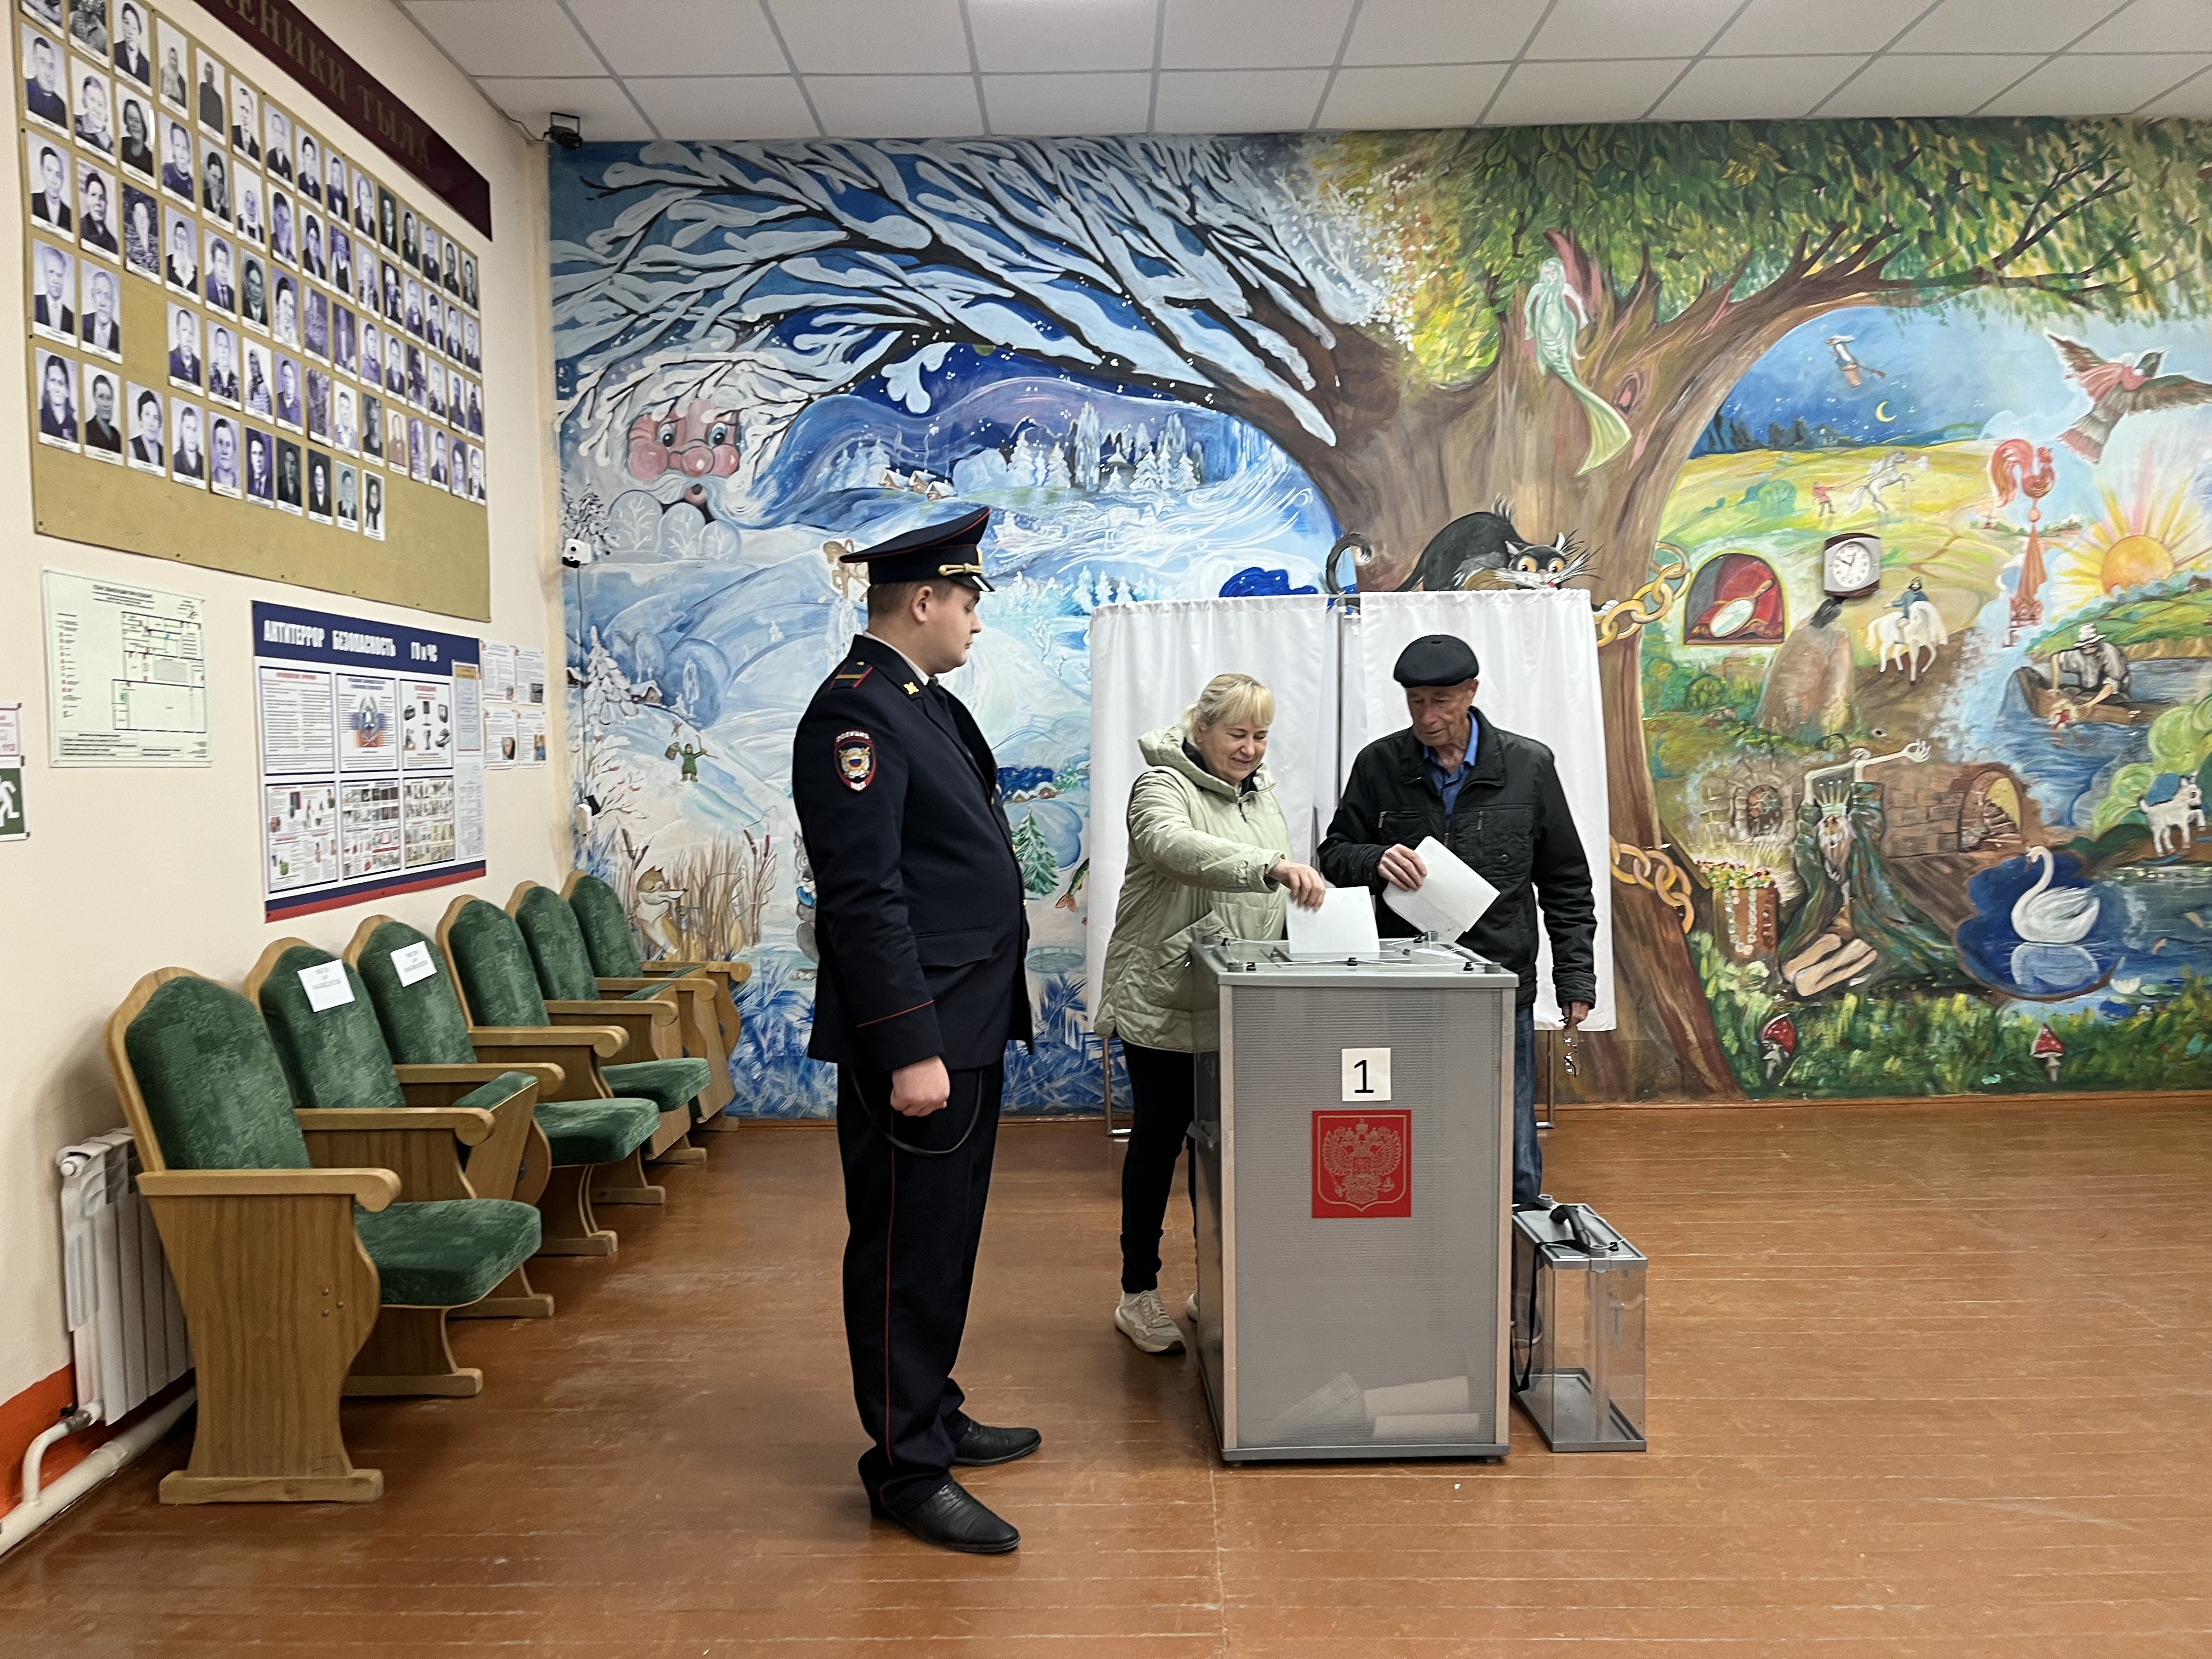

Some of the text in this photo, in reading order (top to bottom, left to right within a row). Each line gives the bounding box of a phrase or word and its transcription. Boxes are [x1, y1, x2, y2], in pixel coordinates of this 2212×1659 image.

[225, 0, 431, 172] ЕНИКИ ТЫЛА
[263, 620, 325, 647] АНТИТЕРРОР
[332, 630, 397, 657] БЕЗОПАСНОСТЬ
[1354, 1059, 1374, 1093] 1
